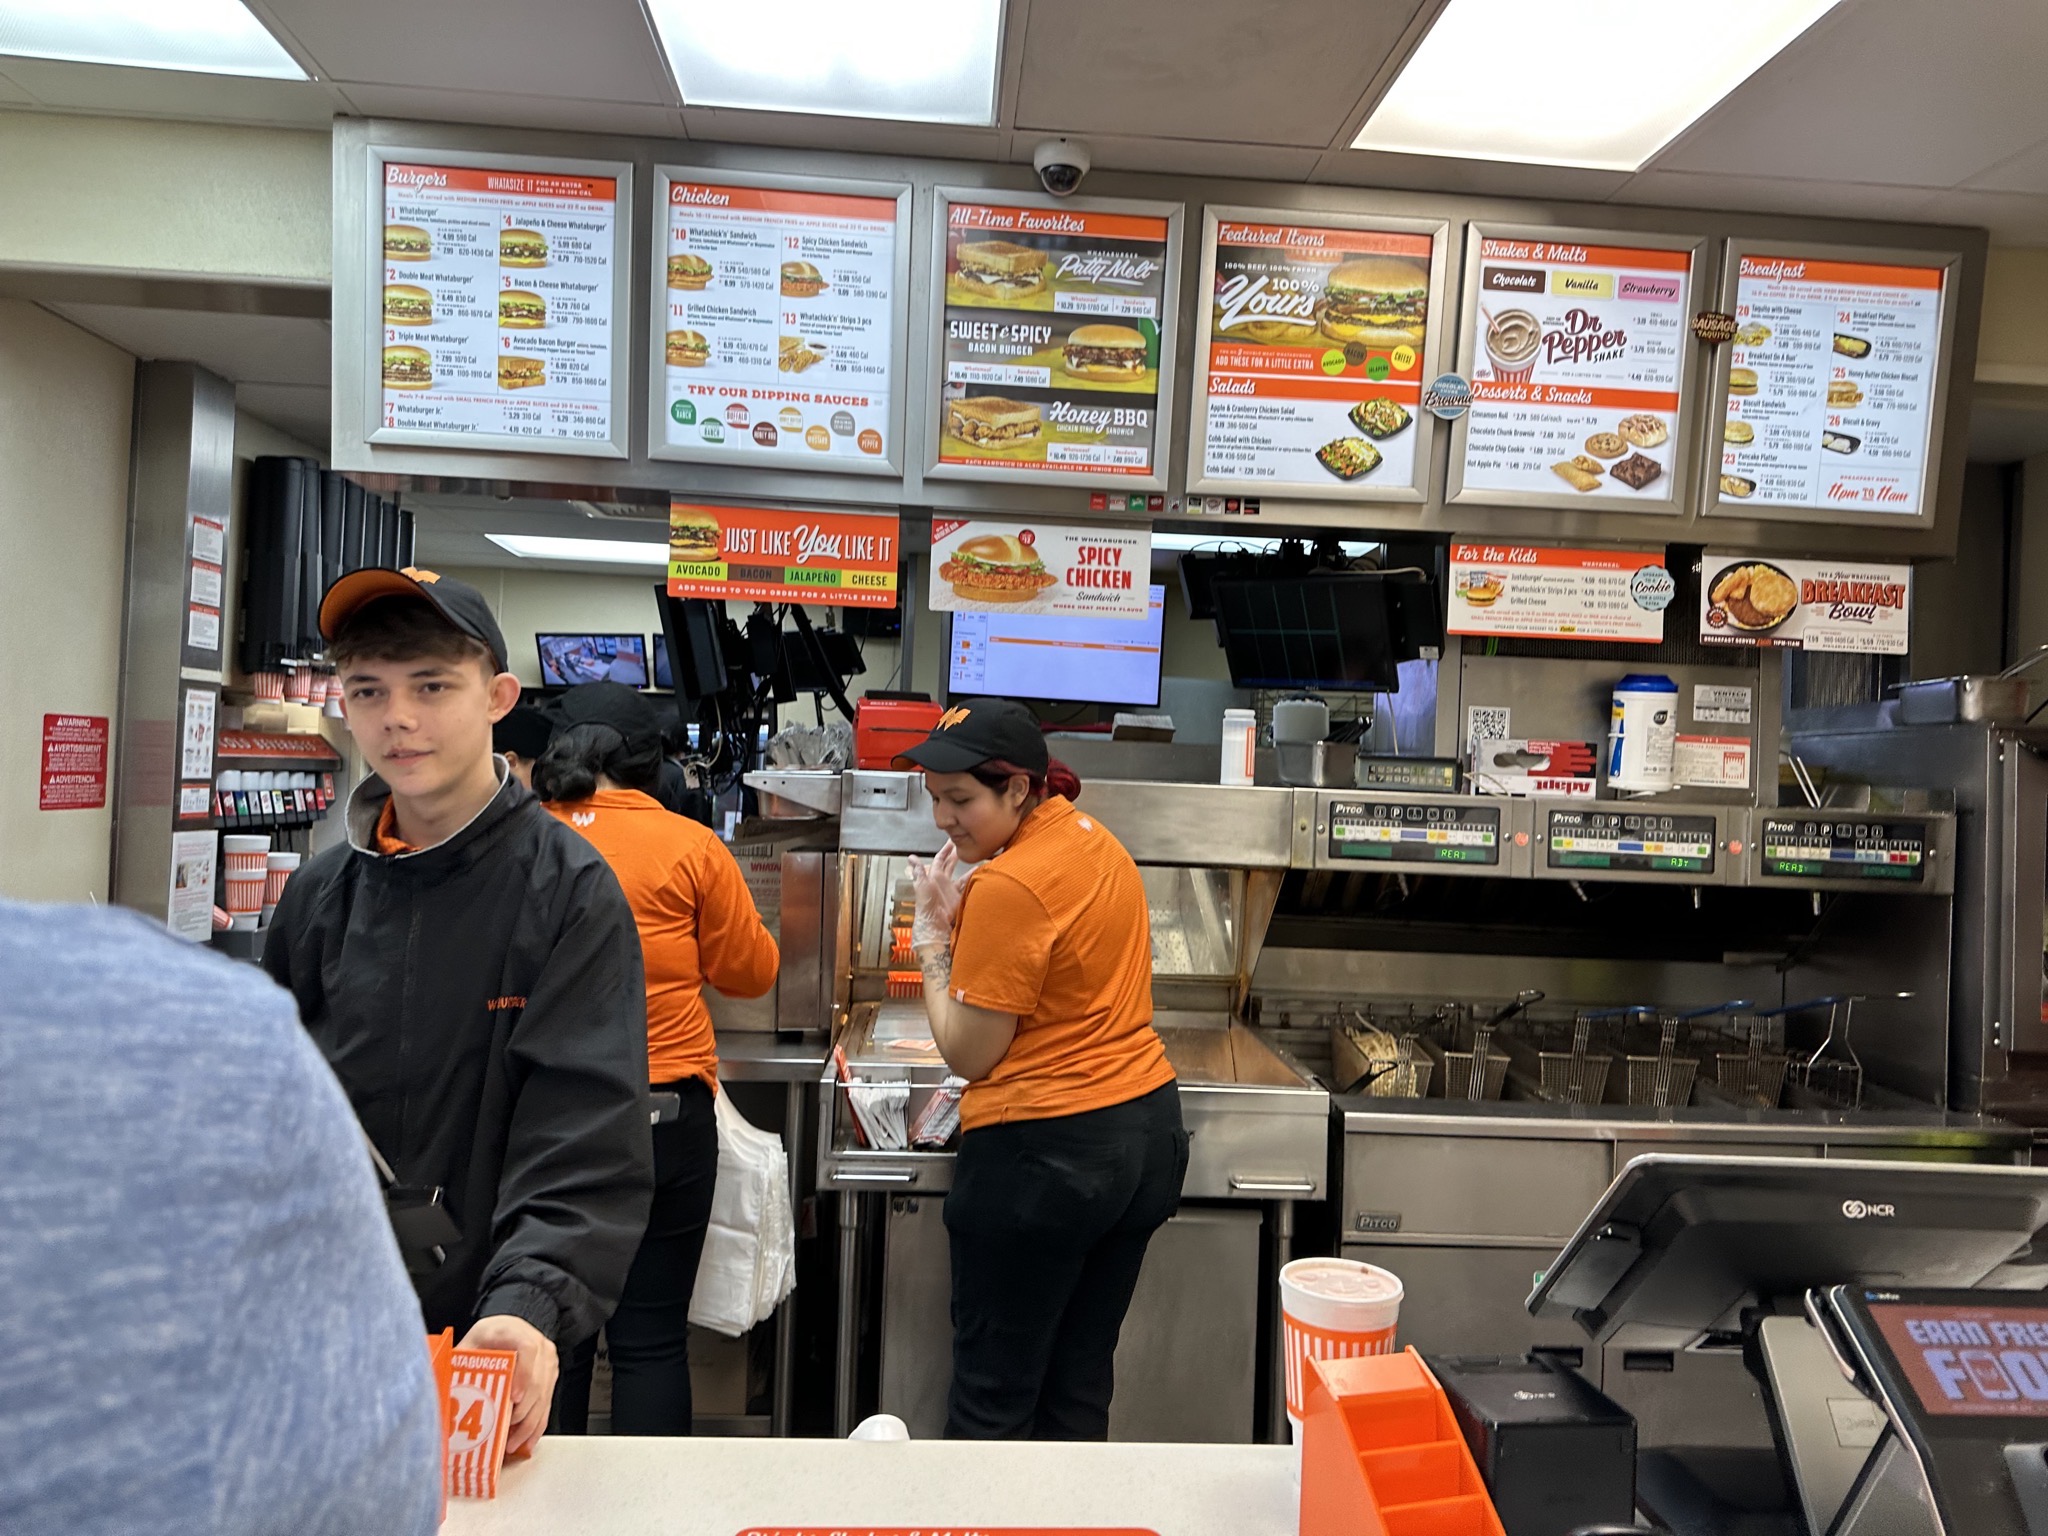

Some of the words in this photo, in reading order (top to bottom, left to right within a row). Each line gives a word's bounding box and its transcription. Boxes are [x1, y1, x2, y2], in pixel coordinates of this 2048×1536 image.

[387, 167, 447, 193] Burgers
[488, 176, 524, 192] WHATASIZE
[527, 178, 534, 192] IT
[672, 186, 730, 206] Chicken
[515, 217, 540, 227] Jalapeño
[541, 219, 545, 227] &
[546, 220, 567, 228] Cheese
[950, 207, 1013, 226] All-Time
[1017, 212, 1085, 232] Favorites
[1219, 224, 1283, 244] Featured
[1286, 229, 1324, 246] Items
[802, 236, 817, 246] Spicy
[818, 237, 839, 247] Chicken
[840, 238, 867, 249] Sandwich
[1087, 250, 1138, 259] WHATABURGER
[1482, 240, 1529, 259] Shakes
[1532, 245, 1543, 258] &
[1547, 244, 1587, 263] Malts
[1056, 253, 1107, 284] Patty
[1106, 258, 1159, 279] Melt
[1740, 260, 1806, 283] Breakfast
[399, 271, 419, 280] Double
[420, 272, 434, 281] Meat
[1493, 273, 1537, 287] Chocolate
[1272, 278, 1319, 292] 100%
[1565, 278, 1598, 291] Vanilla
[1622, 282, 1676, 297] Strawberry
[687, 303, 705, 313] Grilled
[706, 305, 728, 315] Chicken
[729, 306, 757, 316] Sandwich
[1219, 274, 1317, 331] Yours
[1565, 308, 1602, 335] Dr
[1691, 318, 1737, 333] SAUSAGE
[950, 320, 997, 341] SWEET
[1011, 324, 1051, 344] SPICY
[1697, 330, 1730, 339] TAQUITO
[513, 336, 537, 347] Avocado
[538, 338, 555, 346] Bacon
[556, 338, 576, 349] Burger
[968, 342, 997, 354] BACON
[999, 344, 1033, 356] BURGER
[1542, 329, 1627, 365] Pepper
[1216, 356, 1228, 366] ADD
[1231, 356, 1249, 367] THESE
[1251, 356, 1263, 368] FOR
[1265, 357, 1270, 368] A
[1272, 357, 1291, 369] LITTLE
[1293, 359, 1314, 370] EXTRA
[1394, 352, 1412, 365] CHEESE
[1594, 348, 1625, 364] SHAKE
[1323, 359, 1345, 368] AVOCADO
[1209, 377, 1256, 395] Salads
[1435, 382, 1467, 391] CHOCOLATE
[688, 385, 715, 396] TRY
[719, 387, 749, 398] OUR
[752, 389, 810, 403] DIPPING
[814, 391, 869, 407] SAUCES
[1425, 391, 1474, 406] Brownie
[1471, 384, 1527, 400] Desserts
[1530, 386, 1541, 400] &
[1545, 388, 1592, 405] Snacks
[676, 409, 692, 420] RANCH
[1210, 404, 1224, 412] Apple
[1231, 405, 1258, 415] Cranberry
[1259, 406, 1280, 414] Chicken
[1471, 410, 1495, 420] Cinnamon
[1496, 412, 1508, 420] Roll
[1049, 400, 1112, 434] Honey
[1113, 408, 1148, 428] BBQ
[1056, 424, 1078, 433] CHICKEN
[1079, 426, 1094, 434] STRIP
[1106, 427, 1134, 435] SANDWICH
[861, 438, 879, 450] PEPPER
[1862, 487, 1874, 500] TO
[724, 527, 757, 553] JUST
[761, 529, 792, 556] LIKE
[793, 525, 842, 564] You
[845, 535, 873, 561] LIKE
[879, 537, 891, 562] IT
[1081, 536, 1137, 545] WHATABURGER
[1078, 546, 1122, 566] SPICY
[1456, 545, 1480, 561] For
[1483, 547, 1504, 562] the
[1508, 548, 1538, 564] Kids
[676, 565, 720, 576] AVOCADO
[740, 567, 772, 580] BACON
[790, 570, 836, 583] JALAPEÑO
[852, 575, 887, 586] CHEESE
[1066, 568, 1131, 590] CHICKEN
[1635, 578, 1671, 593] Cookie
[678, 584, 695, 592] ADD
[699, 585, 727, 593] THESE
[744, 587, 766, 595] YOUR
[770, 589, 798, 597] ORDER
[1076, 592, 1121, 603] Sandwich
[1801, 579, 1906, 609] BREAKFAST
[1829, 601, 1877, 620] Bowl
[62, 718, 91, 728] WARNING
[54, 744, 102, 753] AVERTISSEMENT
[56, 775, 96, 784] ADVERTENCIA
[1335, 804, 1363, 815] PITCO
[1766, 821, 1794, 833] PITCO
[1868, 1204, 1895, 1217] NCR
[1359, 1216, 1398, 1230] PITCO
[1905, 1320, 1991, 1345] EARN
